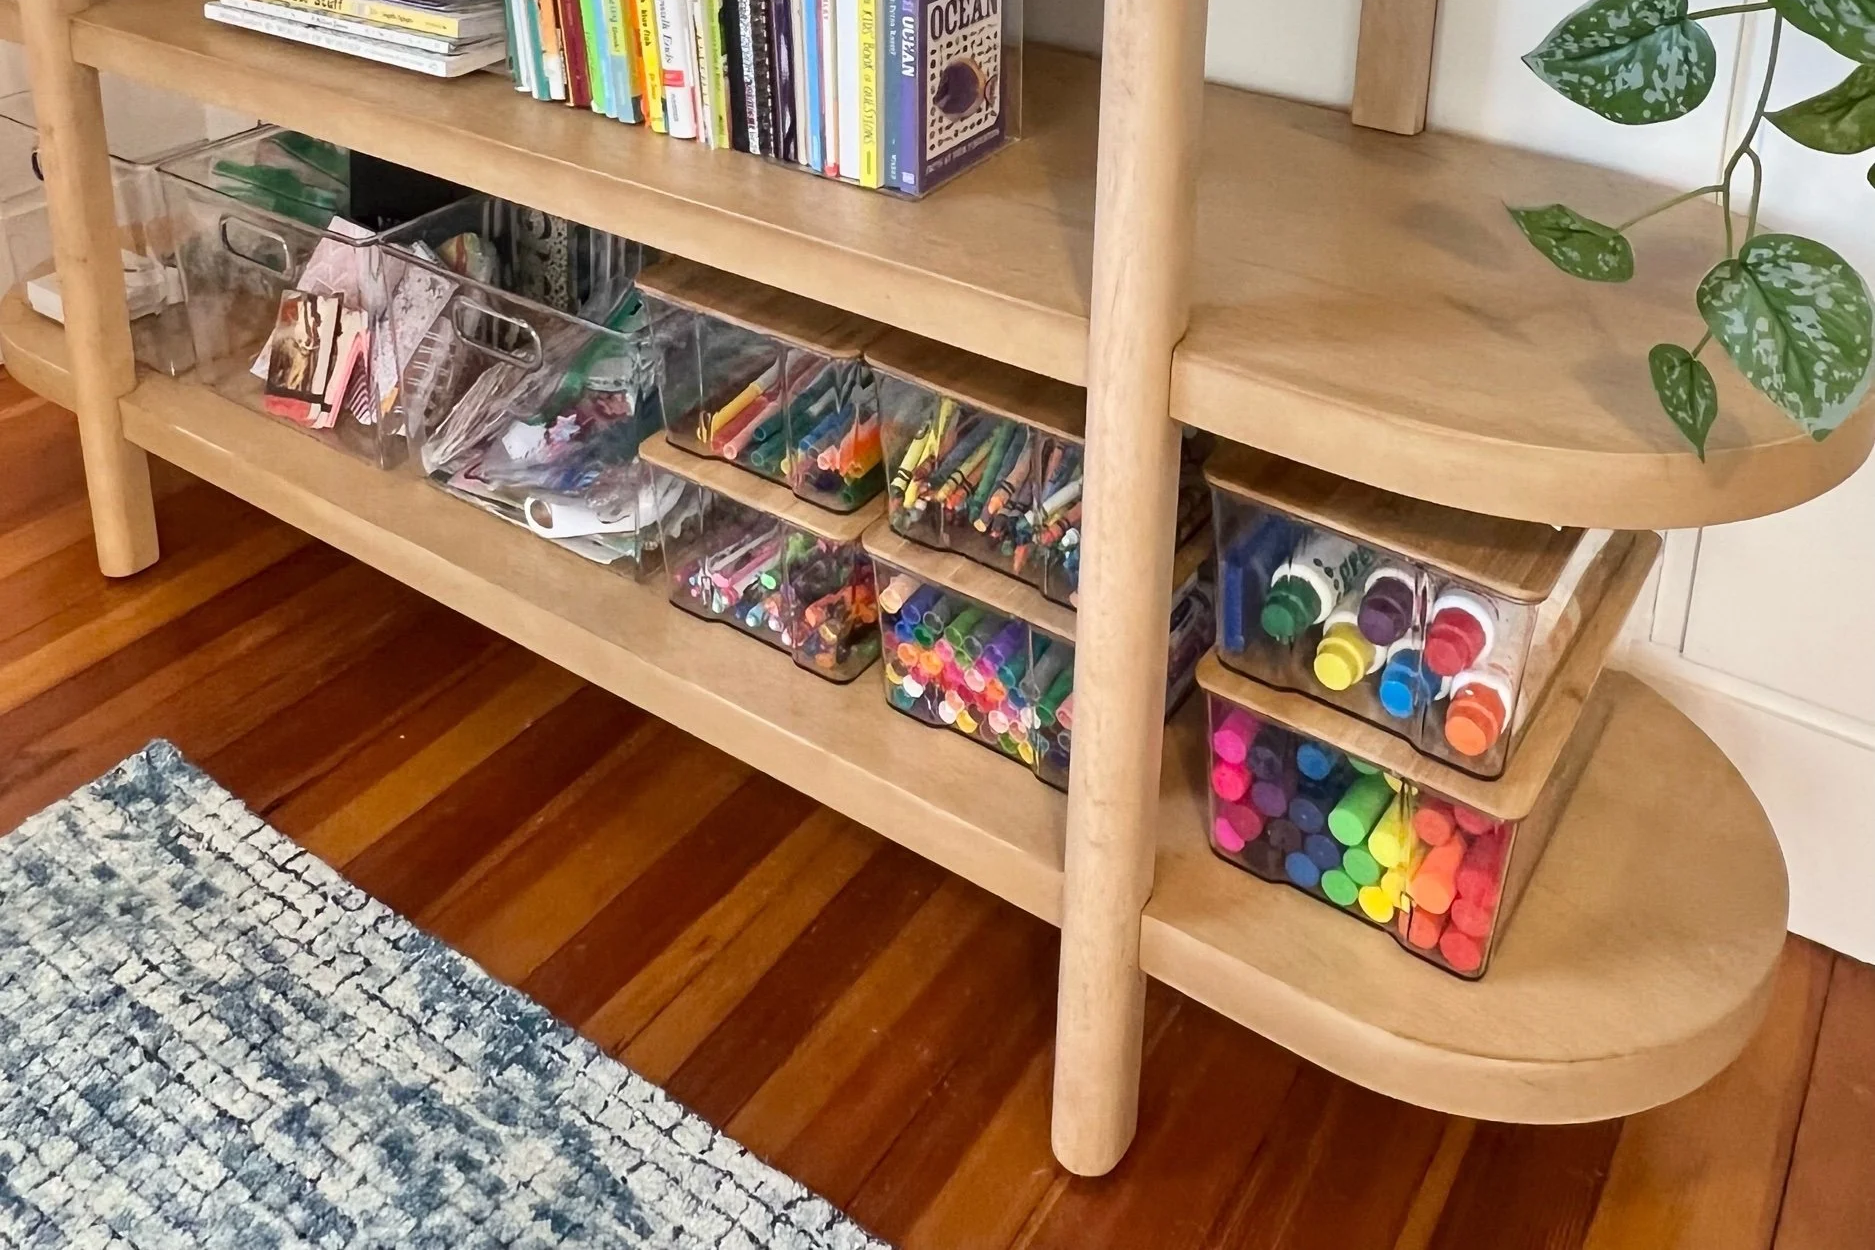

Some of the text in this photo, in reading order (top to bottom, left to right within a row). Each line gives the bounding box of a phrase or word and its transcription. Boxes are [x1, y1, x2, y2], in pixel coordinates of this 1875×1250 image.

[640, 9, 650, 28] blue
[643, 29, 652, 47] fish
[662, 33, 676, 65] Ends
[902, 16, 915, 77] OCEAN
[864, 86, 876, 146] QUESTIONS
